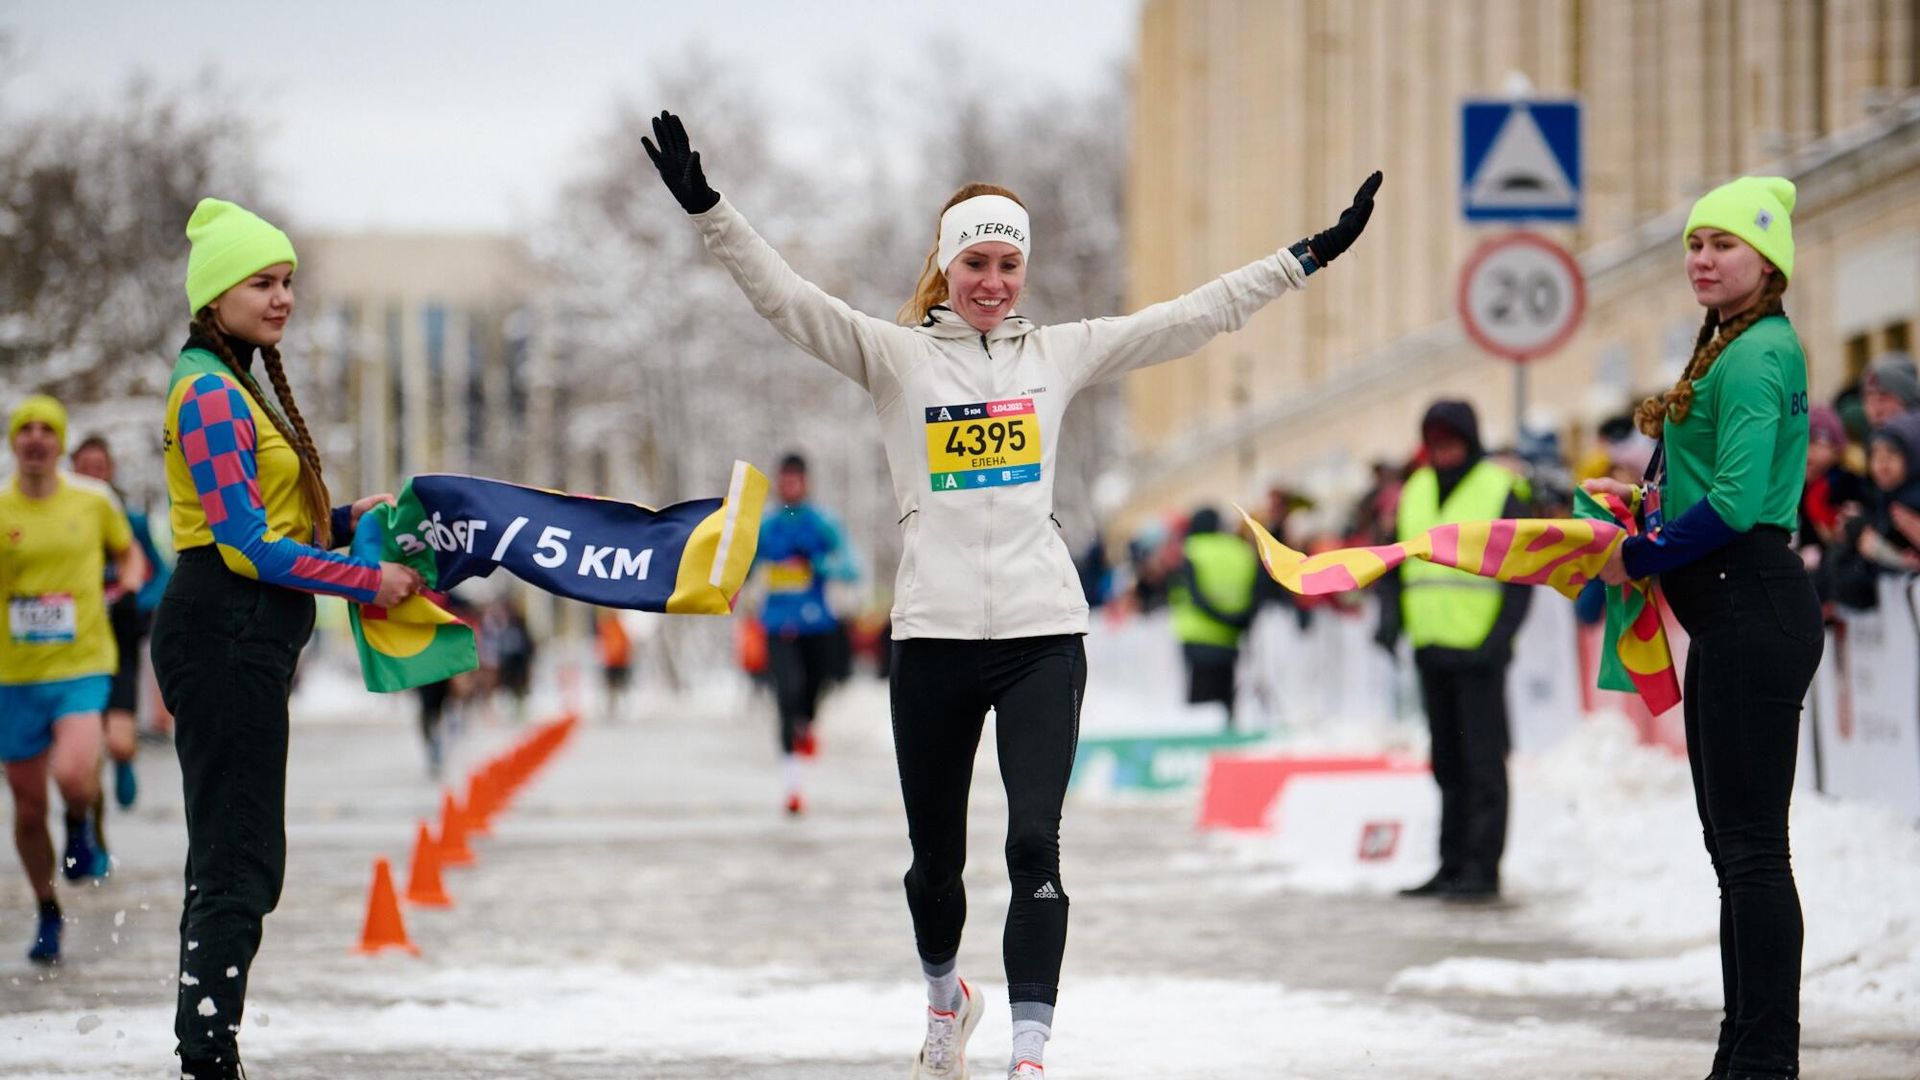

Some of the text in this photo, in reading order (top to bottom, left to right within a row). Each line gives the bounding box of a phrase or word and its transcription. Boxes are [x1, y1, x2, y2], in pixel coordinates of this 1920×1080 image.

[1484, 268, 1561, 326] 20
[945, 420, 1026, 457] 4395
[971, 456, 1007, 468] ЕЛЕНА
[532, 525, 573, 569] 5
